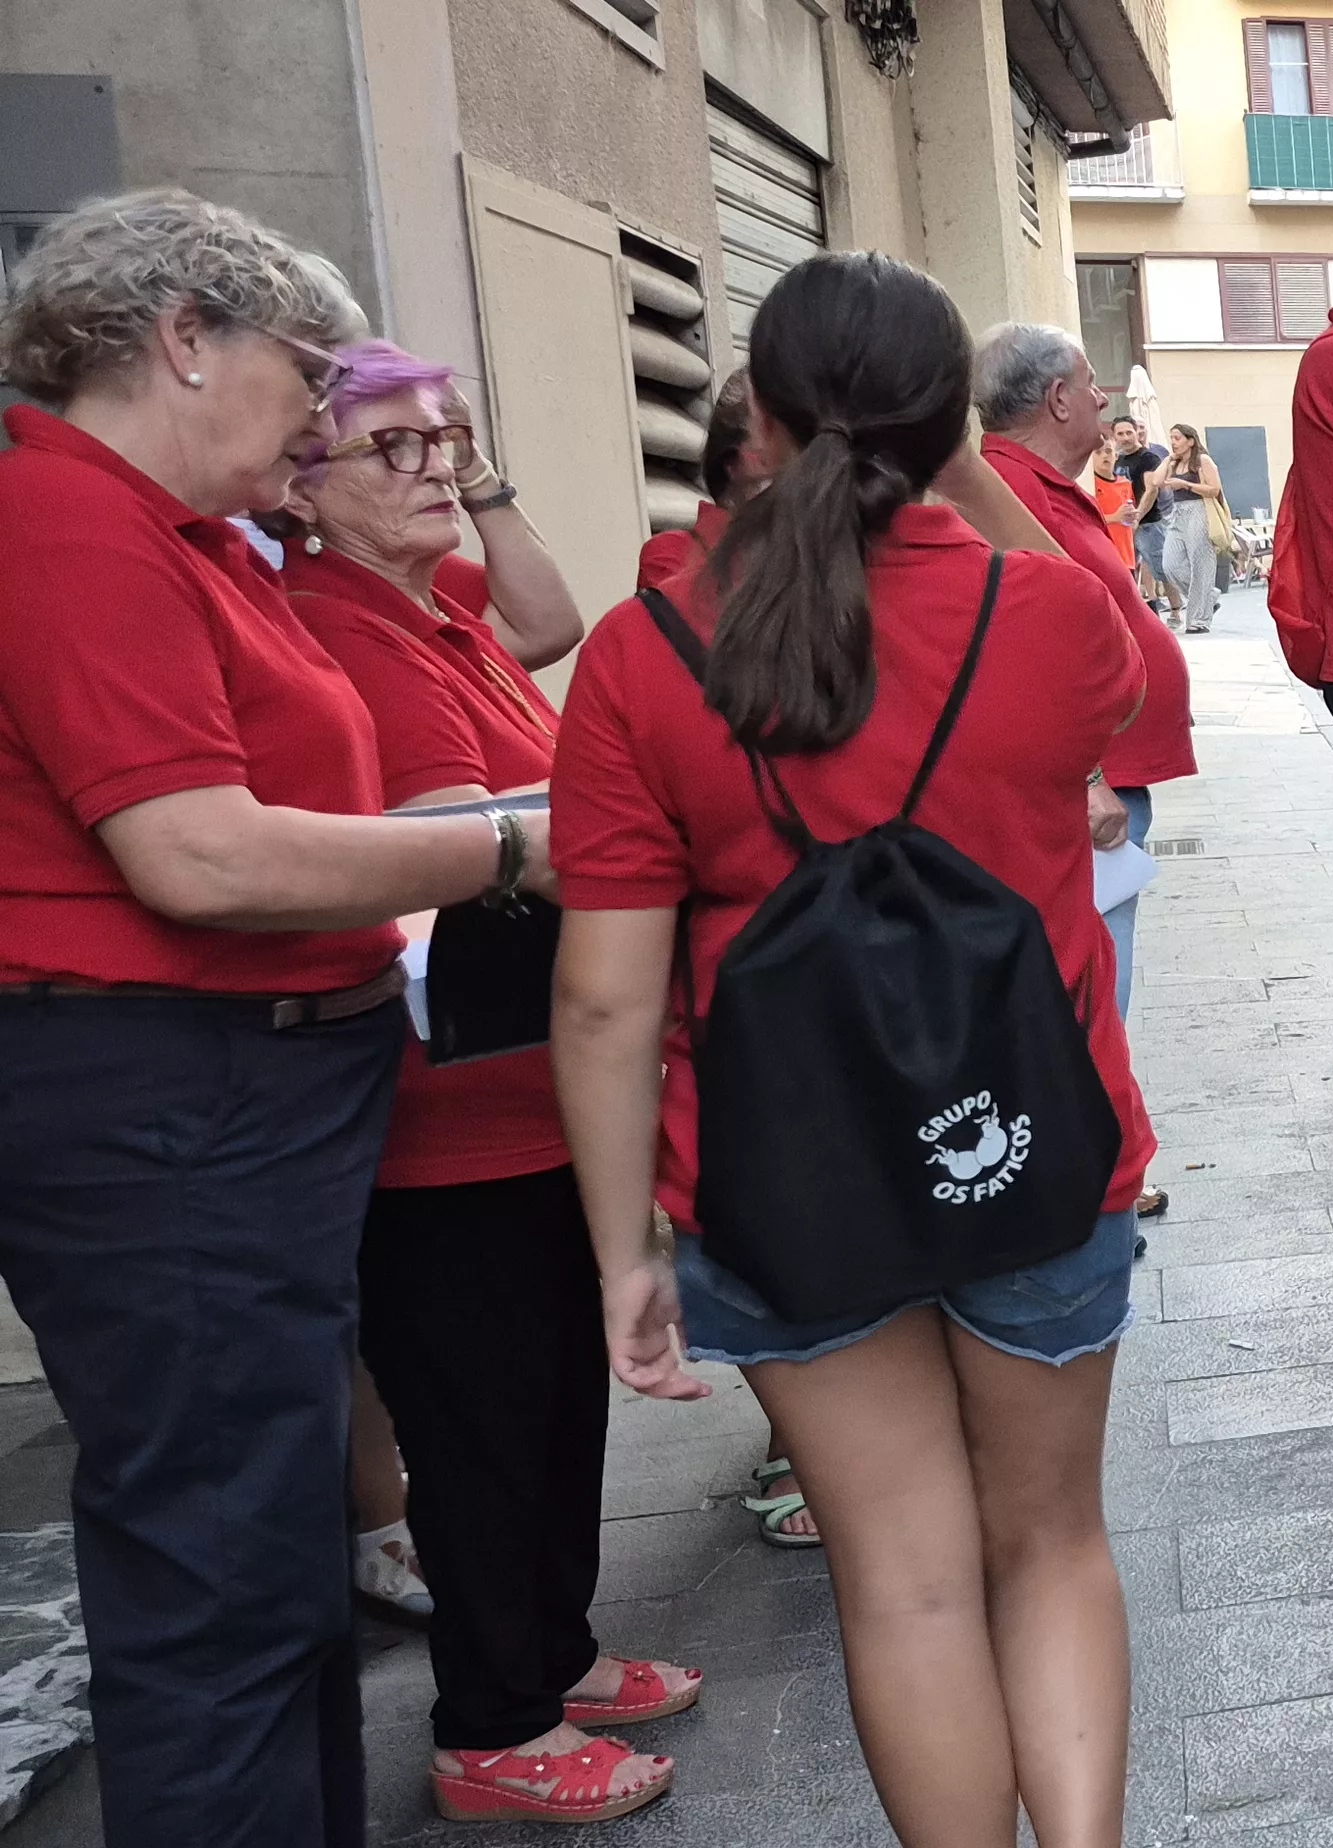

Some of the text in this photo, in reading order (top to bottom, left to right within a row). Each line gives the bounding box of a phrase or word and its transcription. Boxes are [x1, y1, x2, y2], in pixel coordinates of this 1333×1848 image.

[917, 1090, 991, 1142] GRUPO
[932, 1113, 1032, 1204] OS FATICOS
